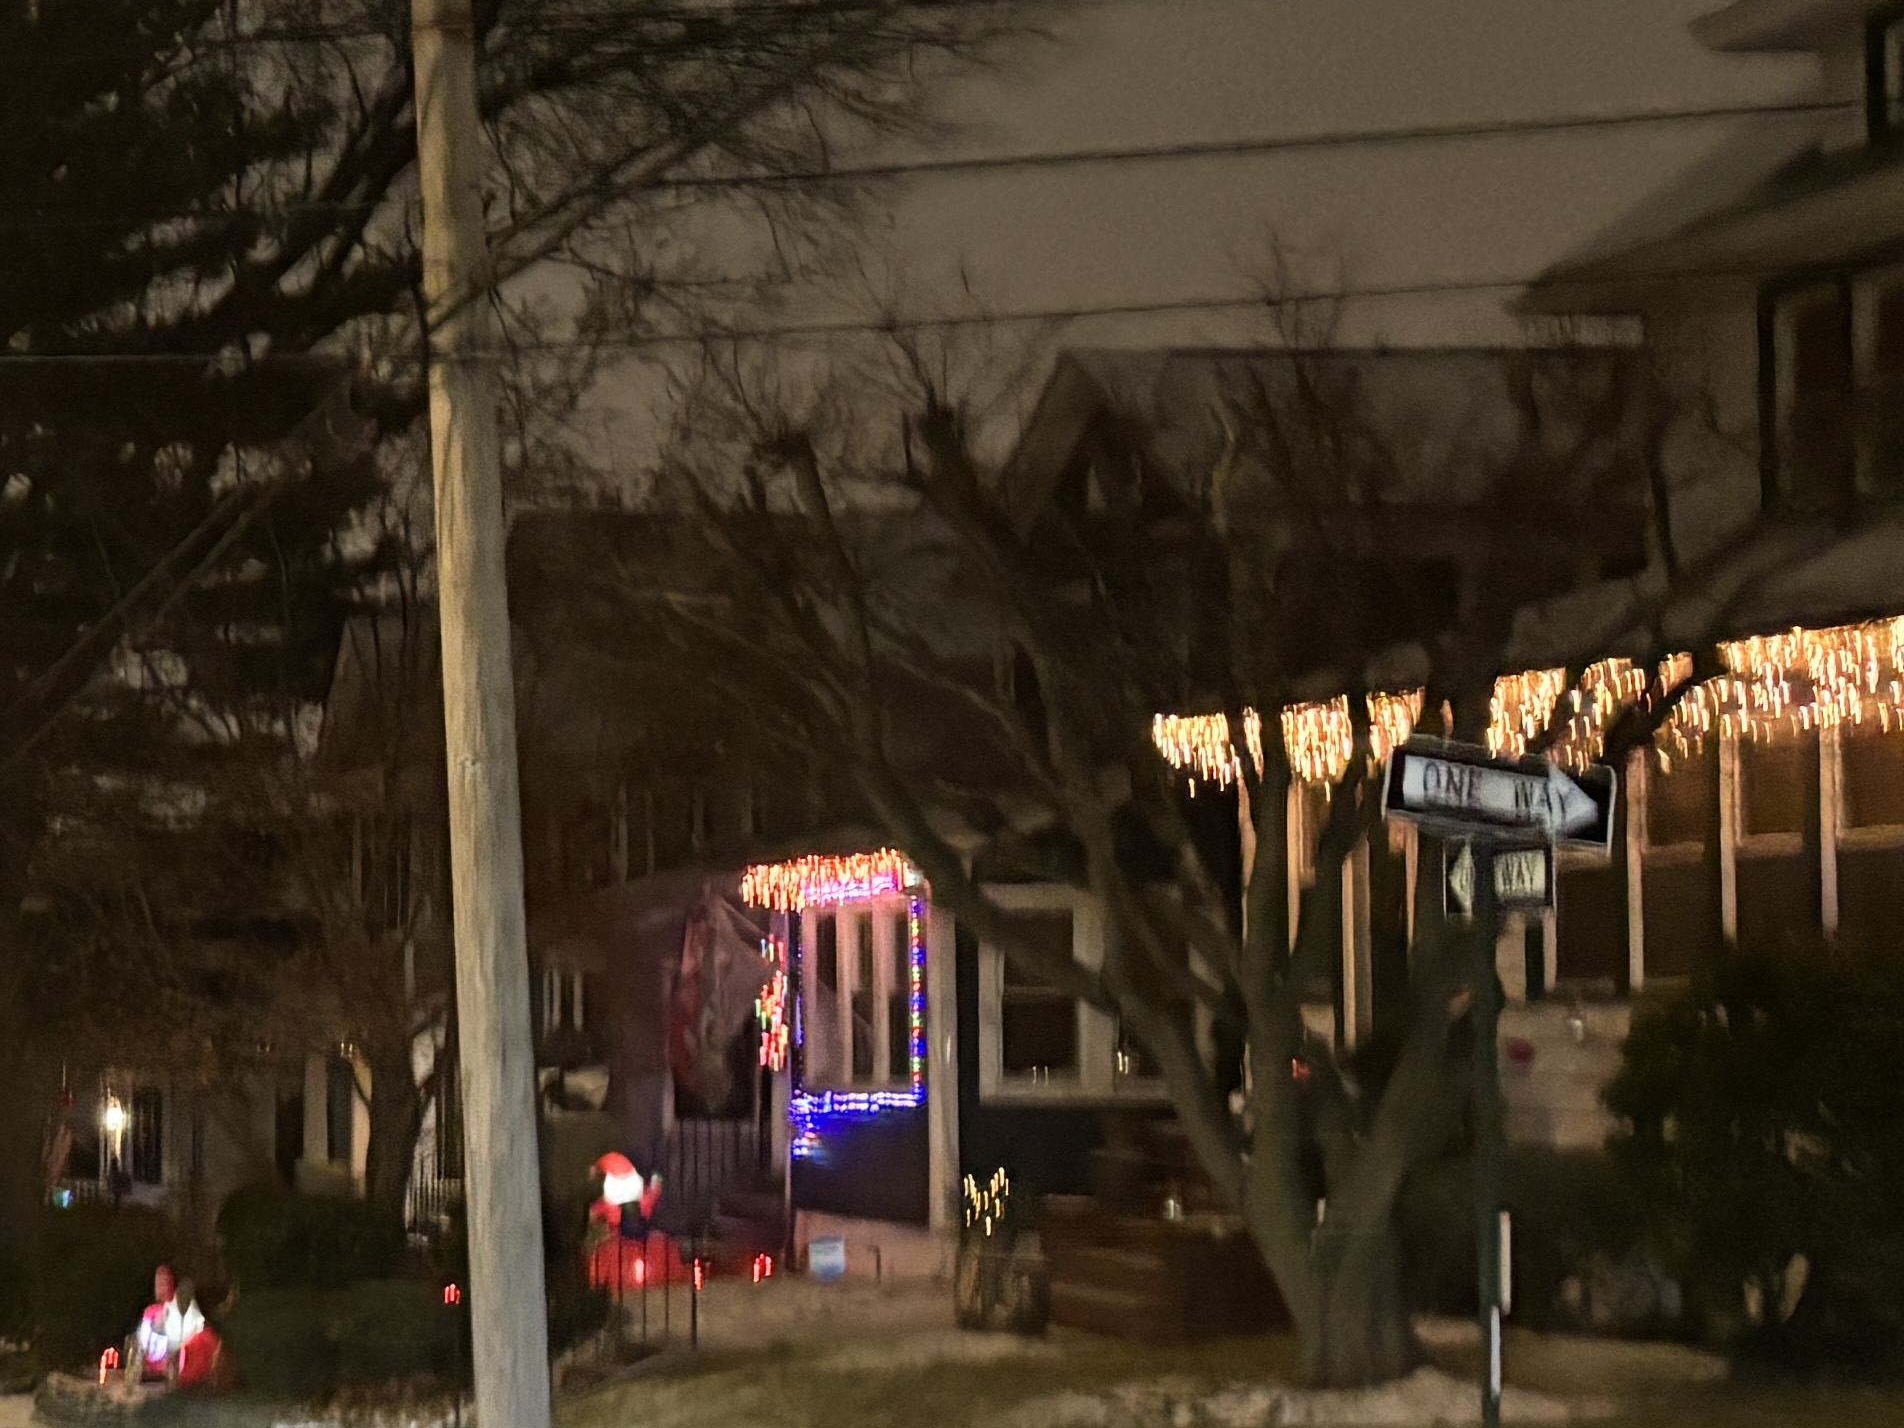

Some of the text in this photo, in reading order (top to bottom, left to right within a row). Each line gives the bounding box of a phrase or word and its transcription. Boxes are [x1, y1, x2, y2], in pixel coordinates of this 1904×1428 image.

[1423, 760, 1573, 820] ONE WAY
[1498, 851, 1538, 893] WAY
